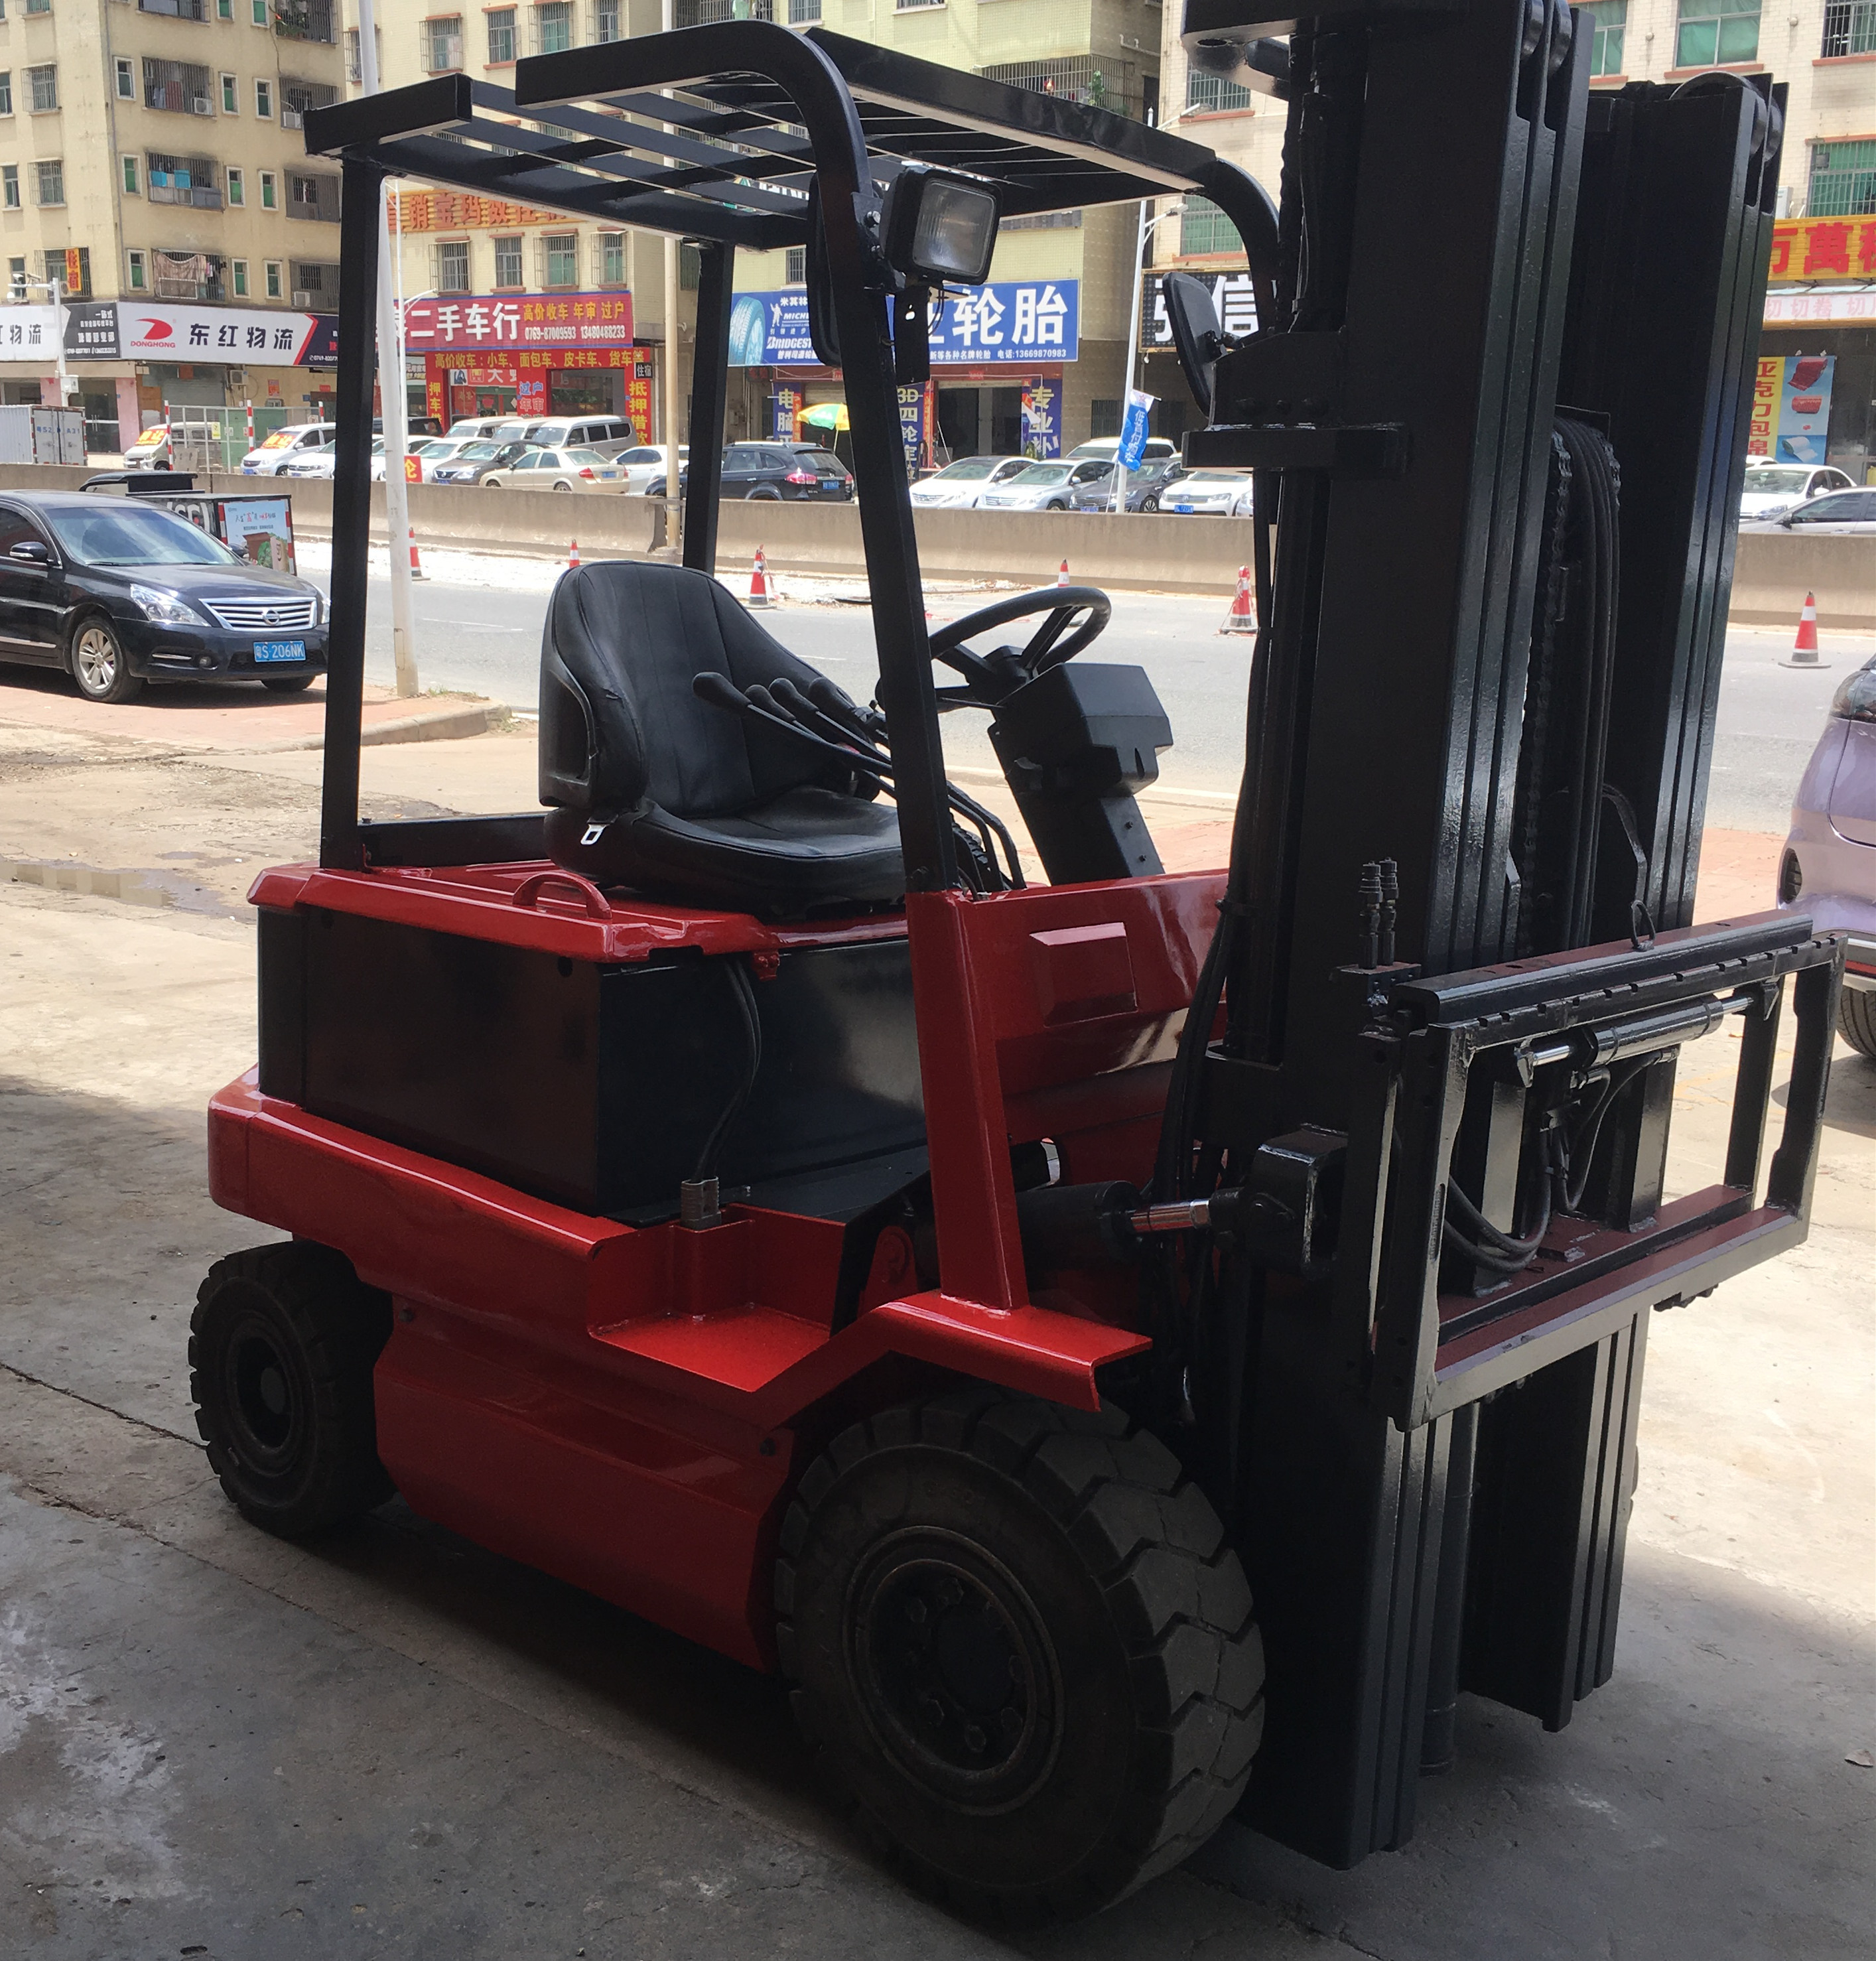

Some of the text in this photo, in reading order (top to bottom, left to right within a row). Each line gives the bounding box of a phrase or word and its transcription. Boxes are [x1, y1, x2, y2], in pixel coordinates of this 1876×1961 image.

[523, 301, 624, 321] 高价收车 年审 过户
[375, 303, 521, 343] 二手车行
[189, 323, 294, 350] 东红物流
[637, 364, 652, 377] 住宿
[519, 381, 544, 395] 过户
[519, 397, 545, 412] 年审
